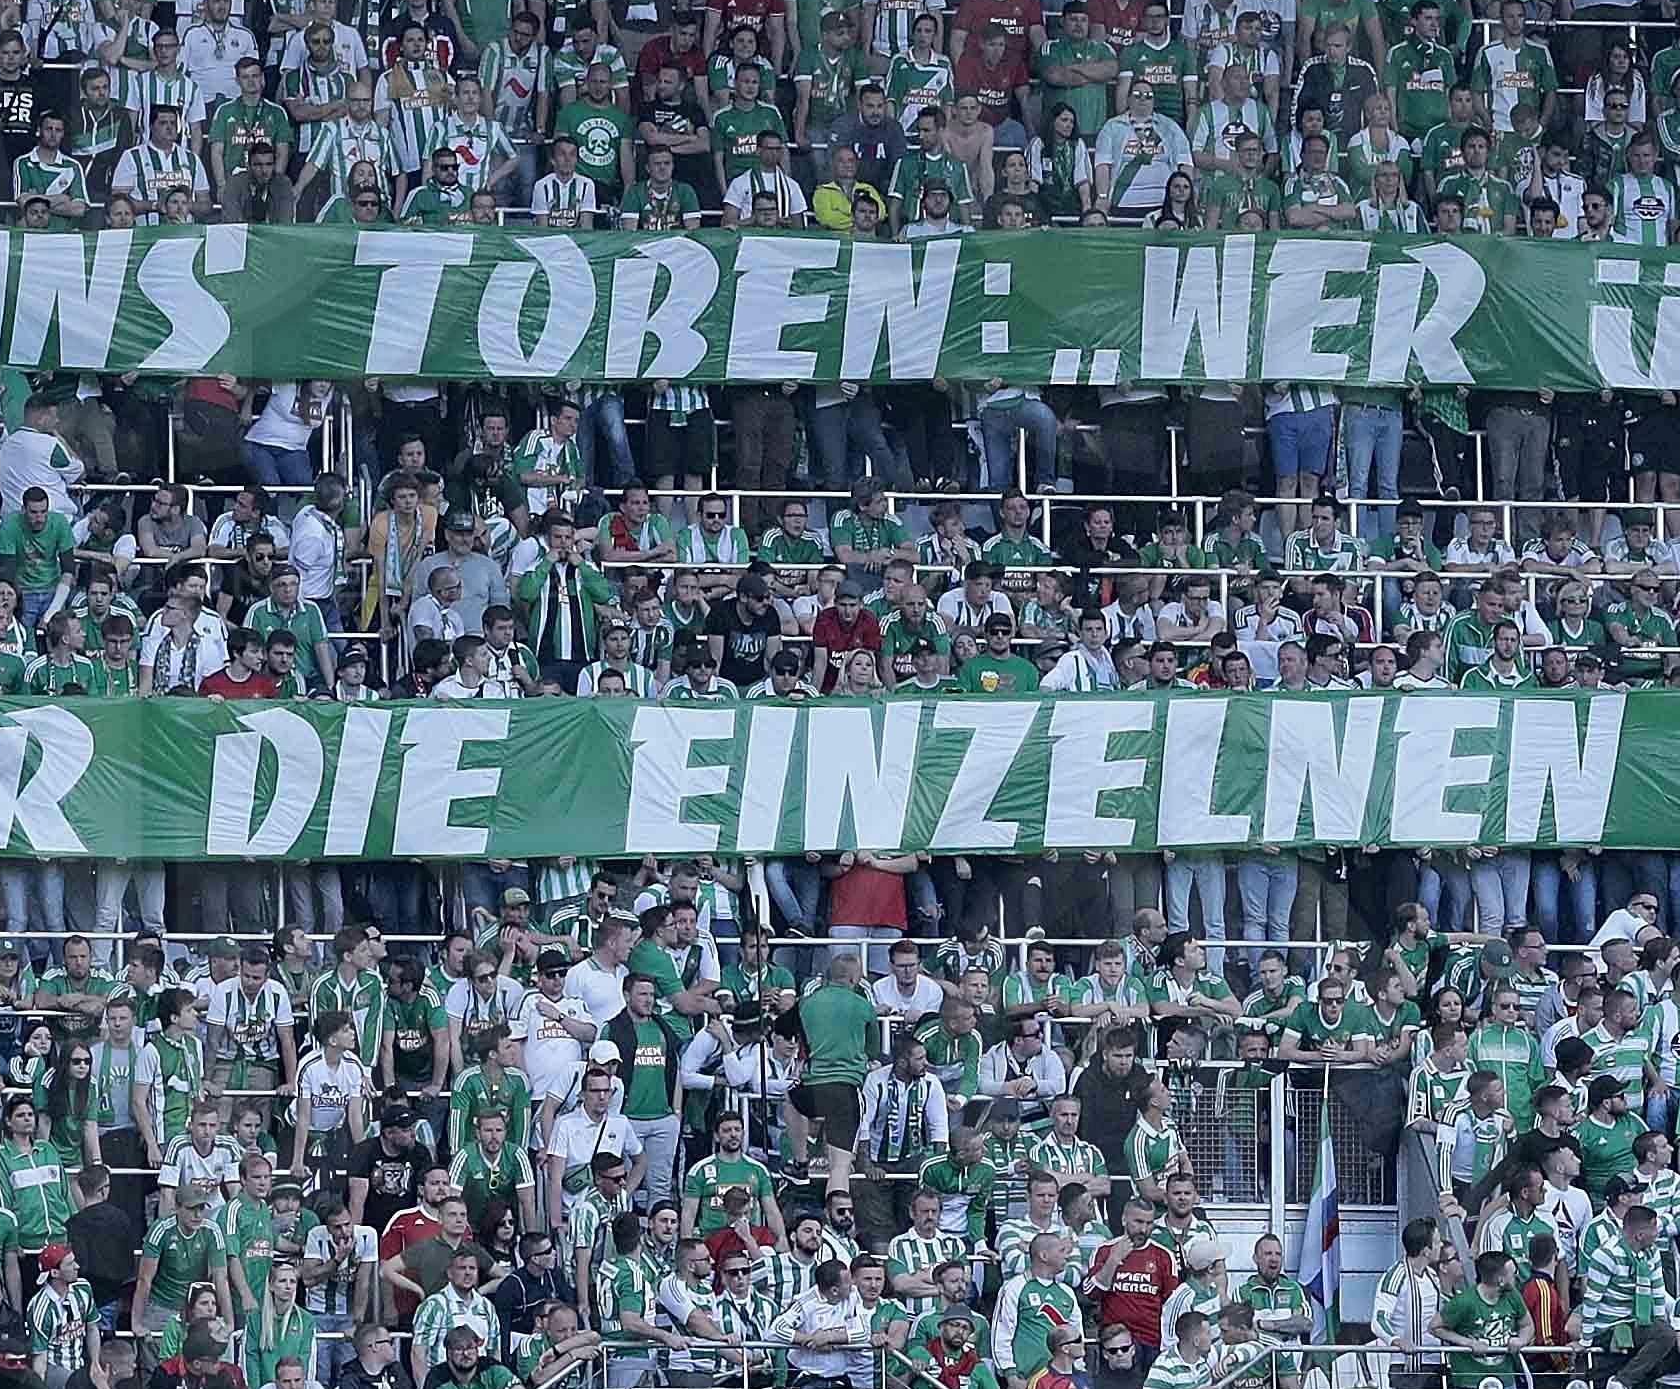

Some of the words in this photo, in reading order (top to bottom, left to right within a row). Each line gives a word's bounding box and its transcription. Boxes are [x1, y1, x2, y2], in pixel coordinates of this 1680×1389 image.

[355, 231, 1009, 380] TOBEN:
[206, 706, 511, 856] DIE
[626, 694, 1628, 853] EINZELNEN
[1113, 1282, 1158, 1294] ENERGIE
[1116, 1272, 1151, 1282] WIEN
